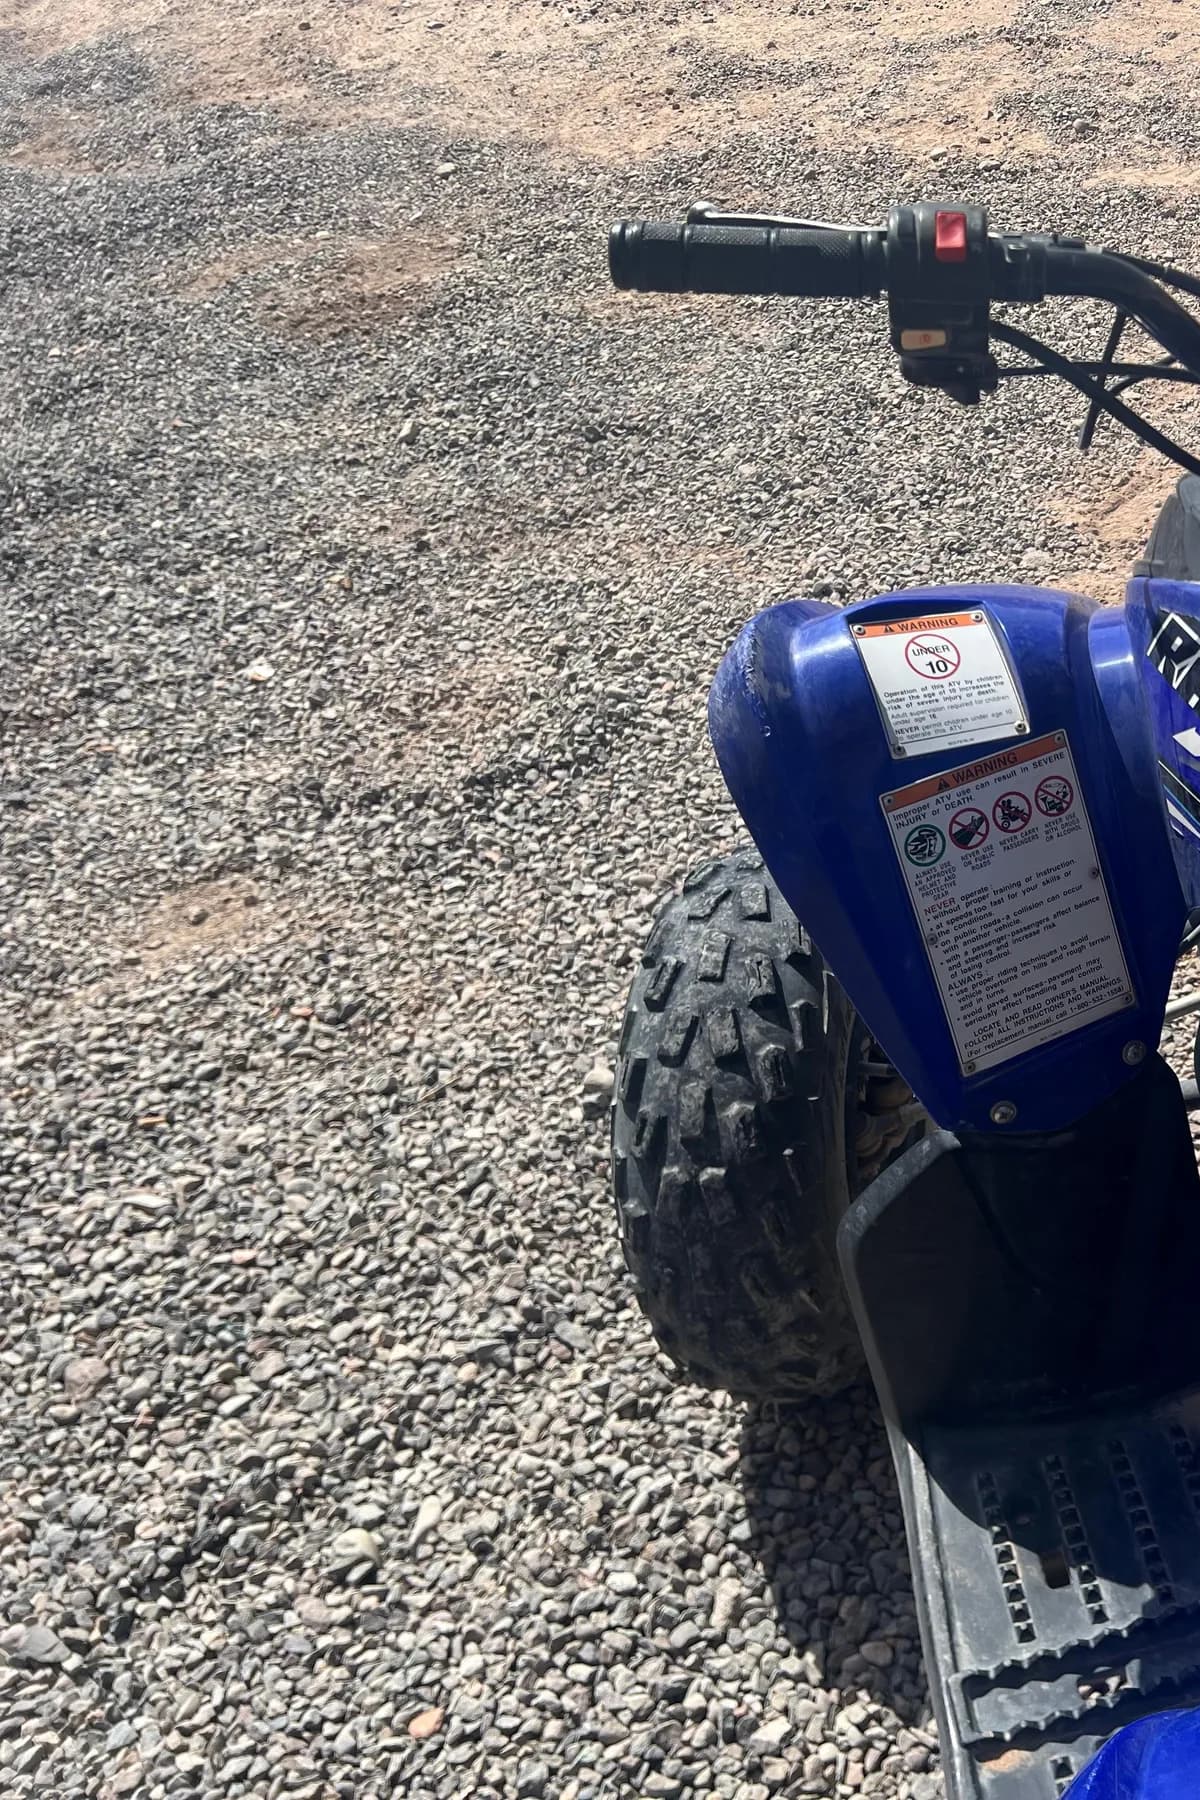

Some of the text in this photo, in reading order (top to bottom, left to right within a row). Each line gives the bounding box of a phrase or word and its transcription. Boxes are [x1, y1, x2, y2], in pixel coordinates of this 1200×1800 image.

[897, 617, 959, 632] WARNING
[912, 645, 950, 657] UNDER
[926, 658, 948, 674] 10
[883, 688, 917, 699] Operation
[959, 683, 991, 692] increases
[905, 701, 913, 709] of
[916, 698, 939, 706] severe
[894, 726, 920, 735] NEVER
[951, 752, 1018, 784] WARNING
[892, 802, 930, 822] Improper
[935, 793, 951, 806] ATV
[956, 788, 971, 798] use
[975, 780, 990, 791] can
[994, 770, 1017, 784] result
[1032, 751, 1065, 769] SEVERE
[895, 812, 926, 830] INJURY
[931, 808, 940, 816] or
[923, 897, 956, 916] NEVER
[932, 904, 961, 921] without
[965, 893, 990, 909] proper
[992, 880, 1022, 896] training
[1024, 875, 1032, 883] or
[935, 922, 944, 930] at
[946, 911, 973, 926] speeds
[973, 905, 987, 914] too
[990, 897, 1005, 907] fast
[1007, 891, 1018, 900] for
[1021, 883, 1038, 896] your
[1063, 870, 1072, 878] or
[940, 939, 951, 947] on
[953, 928, 977, 943] public
[1013, 900, 1044, 917] collision
[1046, 894, 1061, 903] can
[1062, 884, 1083, 896] occur
[937, 929, 950, 938] the
[942, 944, 959, 955] with
[962, 930, 991, 947] another
[945, 953, 961, 964] with
[948, 961, 962, 972] and
[964, 948, 993, 965] steering
[996, 941, 1009, 952] and
[1043, 922, 1057, 931] risk
[950, 971, 958, 979] of
[960, 961, 983, 975] losing
[957, 989, 983, 1004] vehicle
[985, 974, 1018, 992] overturns
[1021, 968, 1031, 976] on
[1032, 961, 1048, 971] hills
[1051, 953, 1064, 964] and
[1066, 944, 1087, 957] rough
[971, 975, 994, 991] proper
[997, 966, 1018, 978] riding
[1020, 948, 1058, 968] techniques
[1059, 944, 1068, 952] to
[1070, 934, 1089, 947] avoid
[962, 1006, 983, 1020] avoid
[986, 995, 1009, 1011] paved
[964, 1009, 998, 1028] seriously
[1002, 998, 1023, 1011] affect
[1025, 983, 1057, 1001] handling
[1061, 975, 1074, 986] and
[975, 997, 984, 1005] in
[964, 1031, 994, 1050] FOLLOW
[997, 1024, 1011, 1035] ALL
[1013, 1001, 1065, 1027] INSTRUCTIONS
[1067, 993, 1082, 1005] AND
[973, 1020, 1002, 1037] LOCATE
[1005, 1012, 1020, 1024] AND
[1022, 1002, 1042, 1016] READ
[984, 1028, 1025, 1051] replacement
[1055, 1010, 1068, 1020] call
